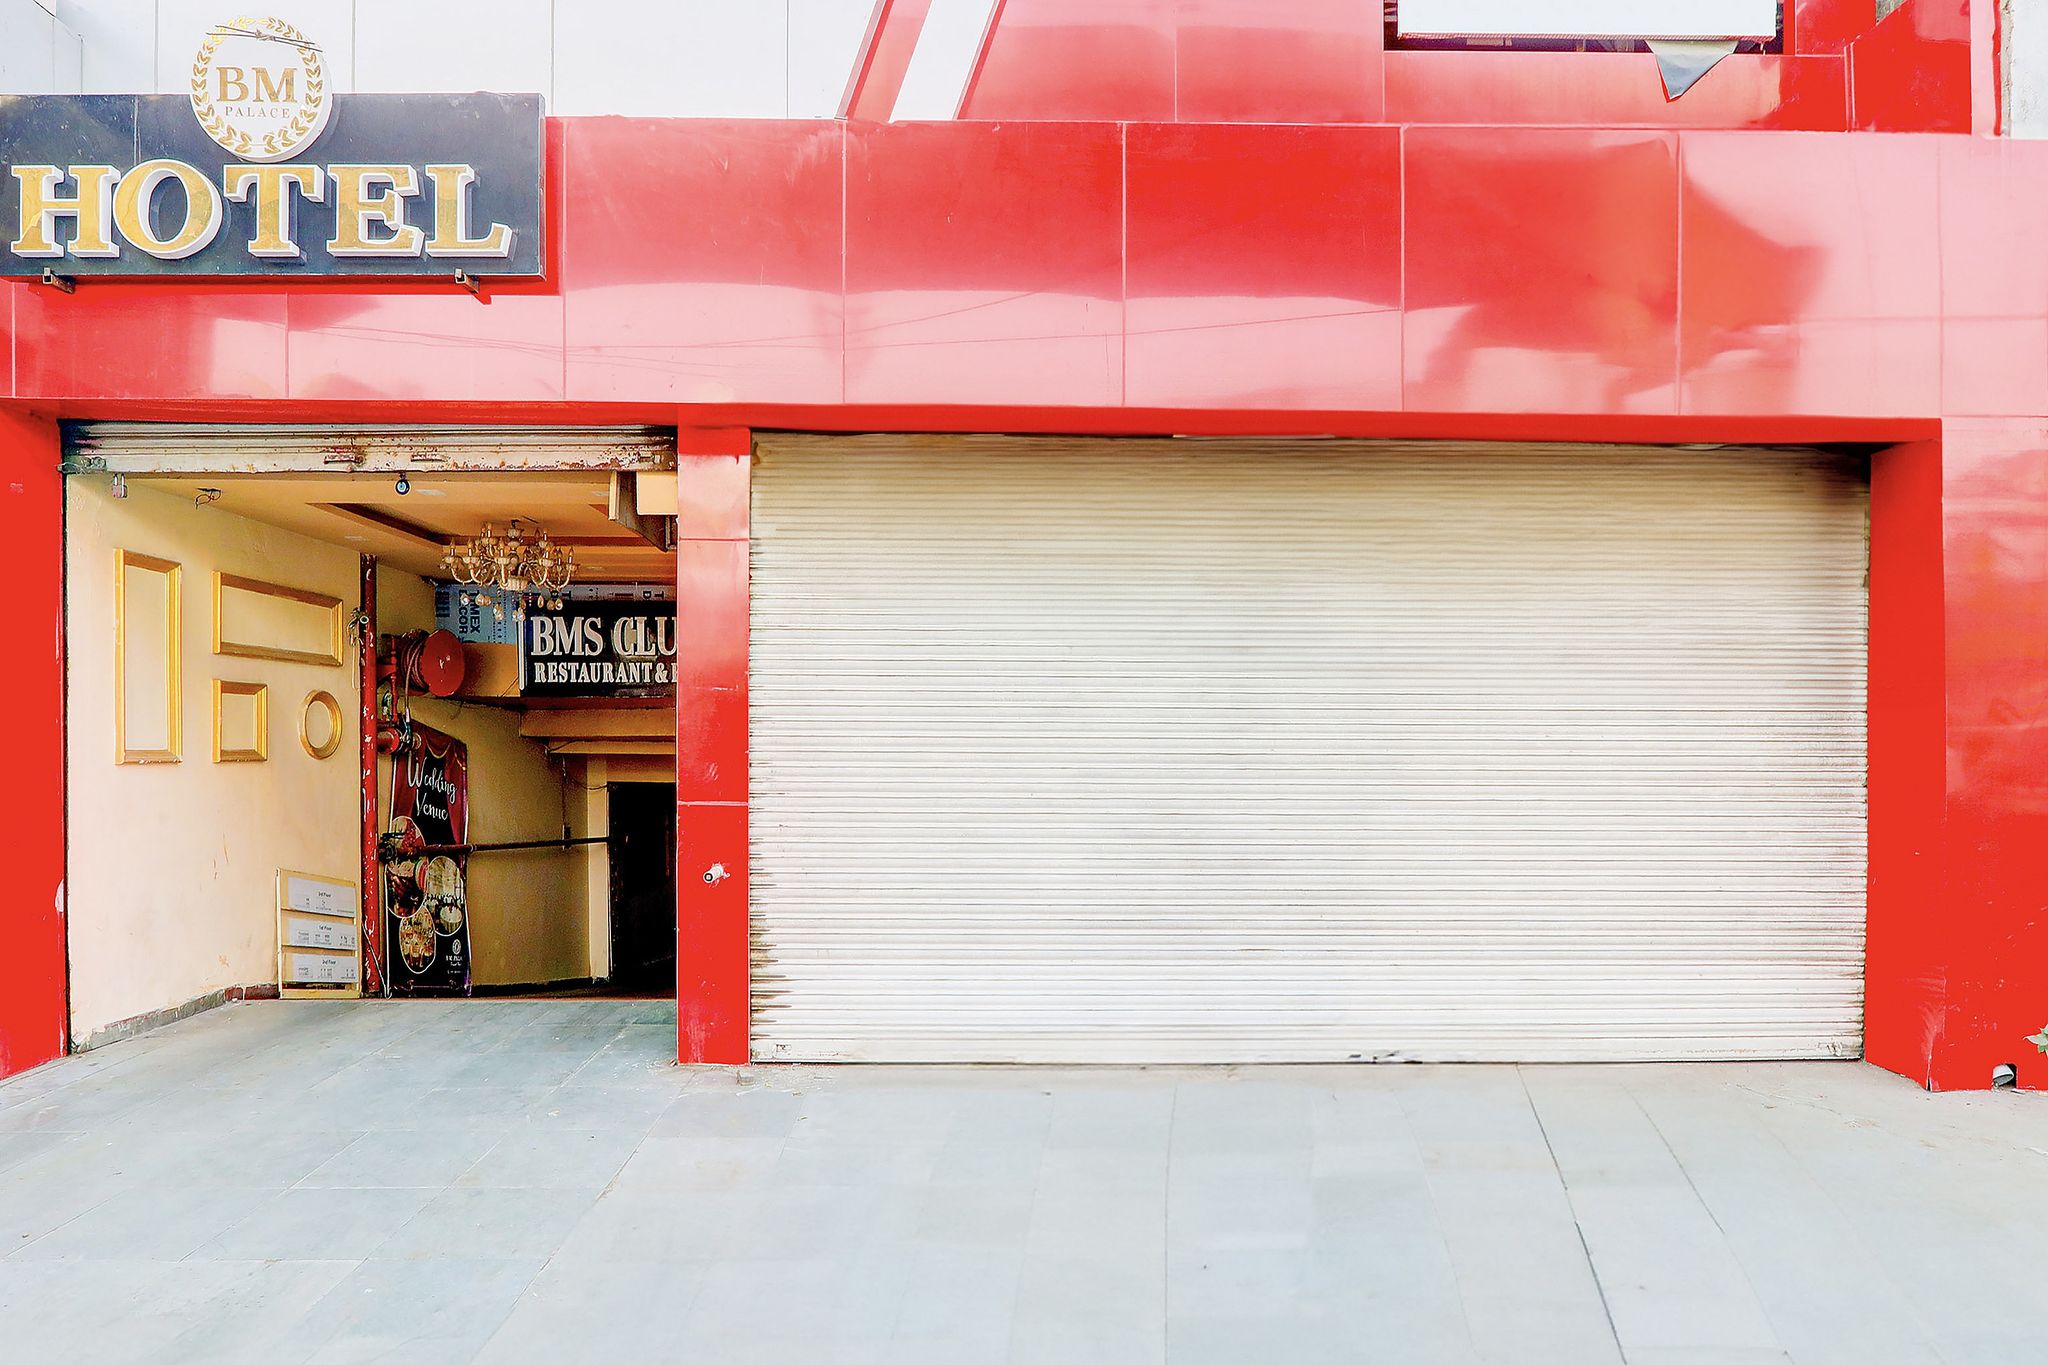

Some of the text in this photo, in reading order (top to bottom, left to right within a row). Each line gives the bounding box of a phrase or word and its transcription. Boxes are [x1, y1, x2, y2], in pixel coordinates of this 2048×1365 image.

[216, 66, 298, 104] BM
[225, 106, 291, 119] PALACE
[10, 159, 513, 261] HOTEL
[471, 589, 481, 634] TMEX
[530, 616, 603, 656] BMS
[407, 756, 456, 805] Wedding
[416, 788, 448, 821] Venue
